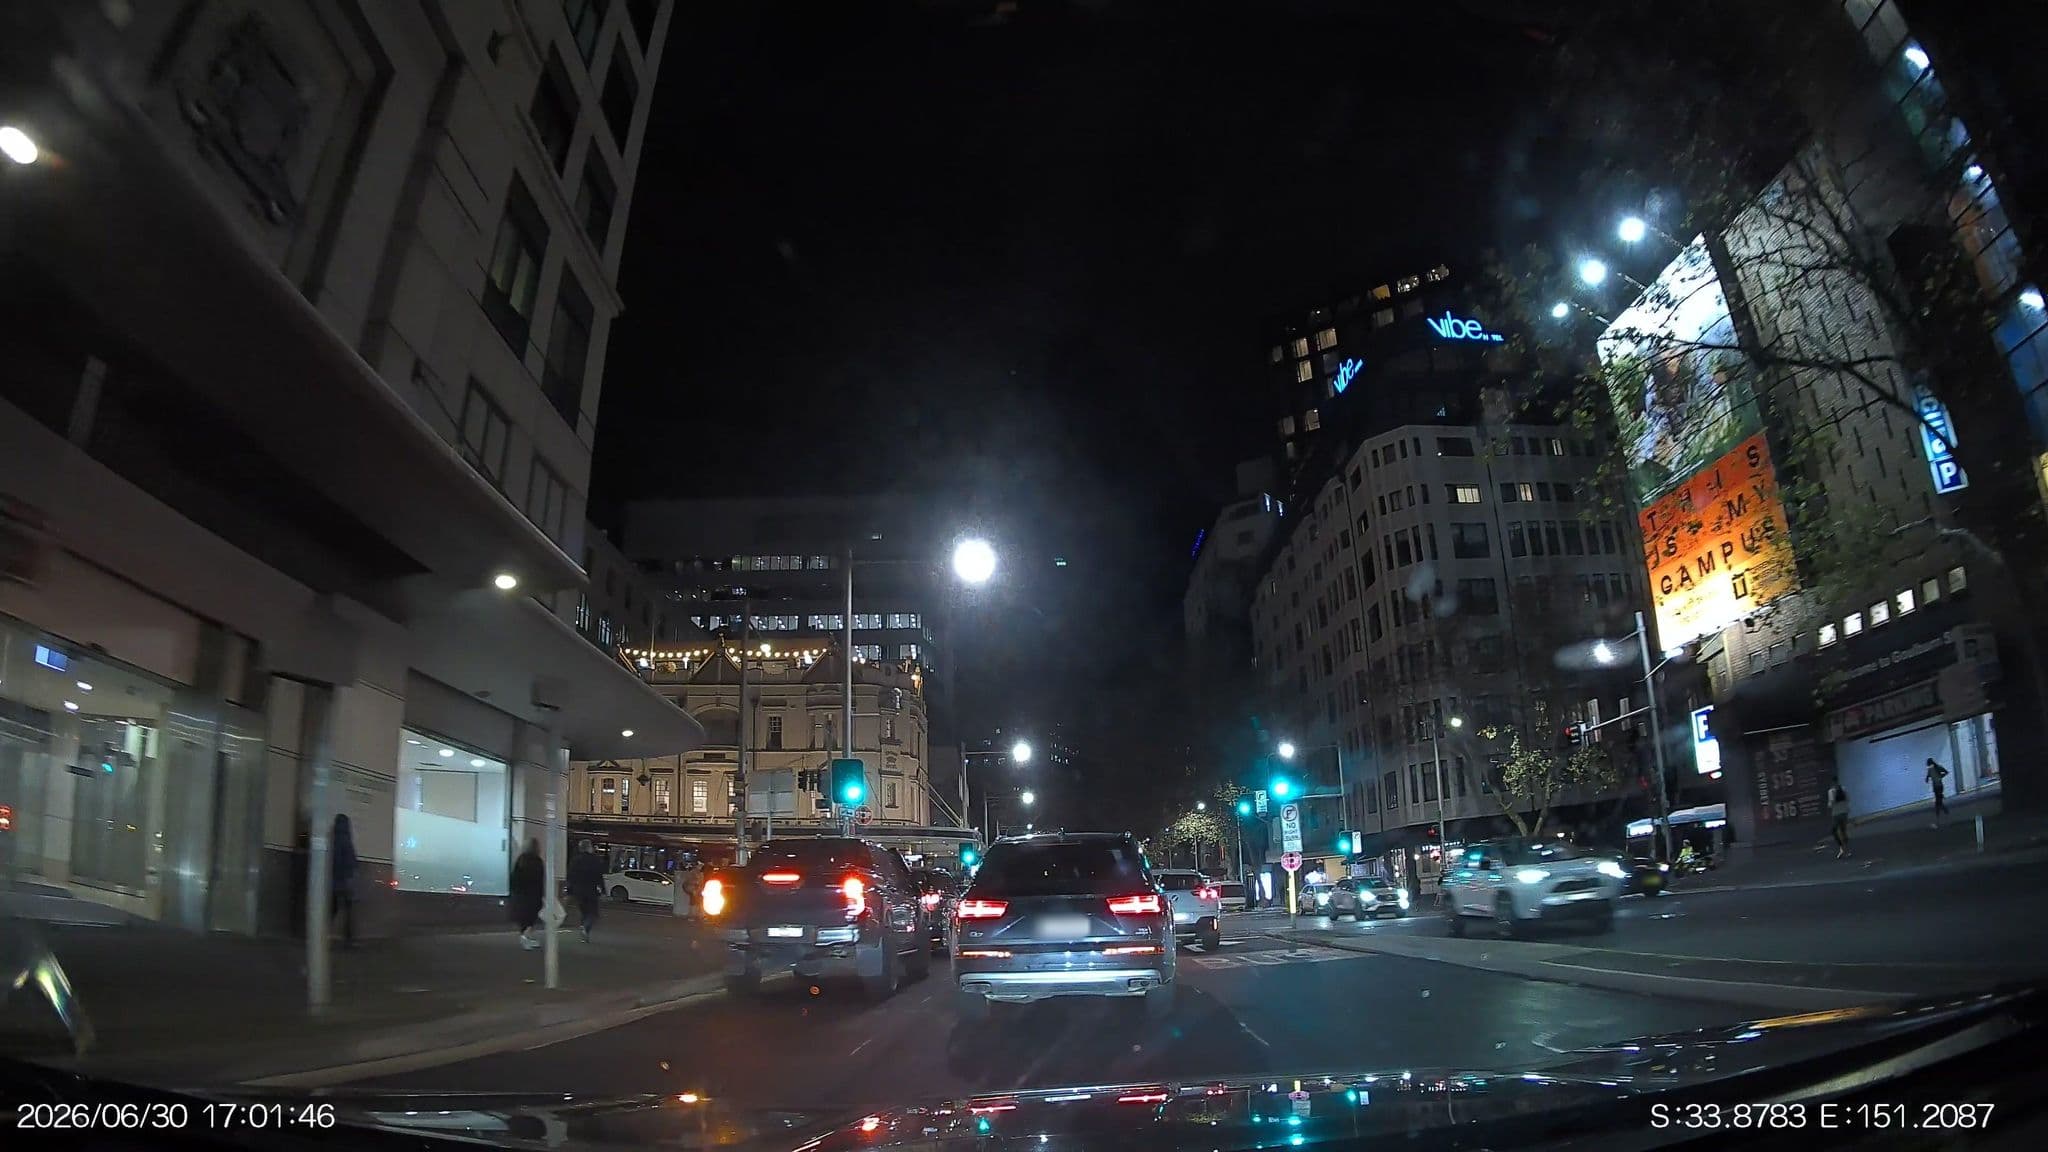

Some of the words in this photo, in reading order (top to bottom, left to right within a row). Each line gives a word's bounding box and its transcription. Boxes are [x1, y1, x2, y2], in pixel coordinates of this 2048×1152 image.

[1427, 310, 1482, 339] vibe
[1334, 358, 1355, 393] vibe
[1647, 445, 1761, 531] THIS
[1938, 461, 1958, 486] P
[1727, 480, 1767, 522] MY
